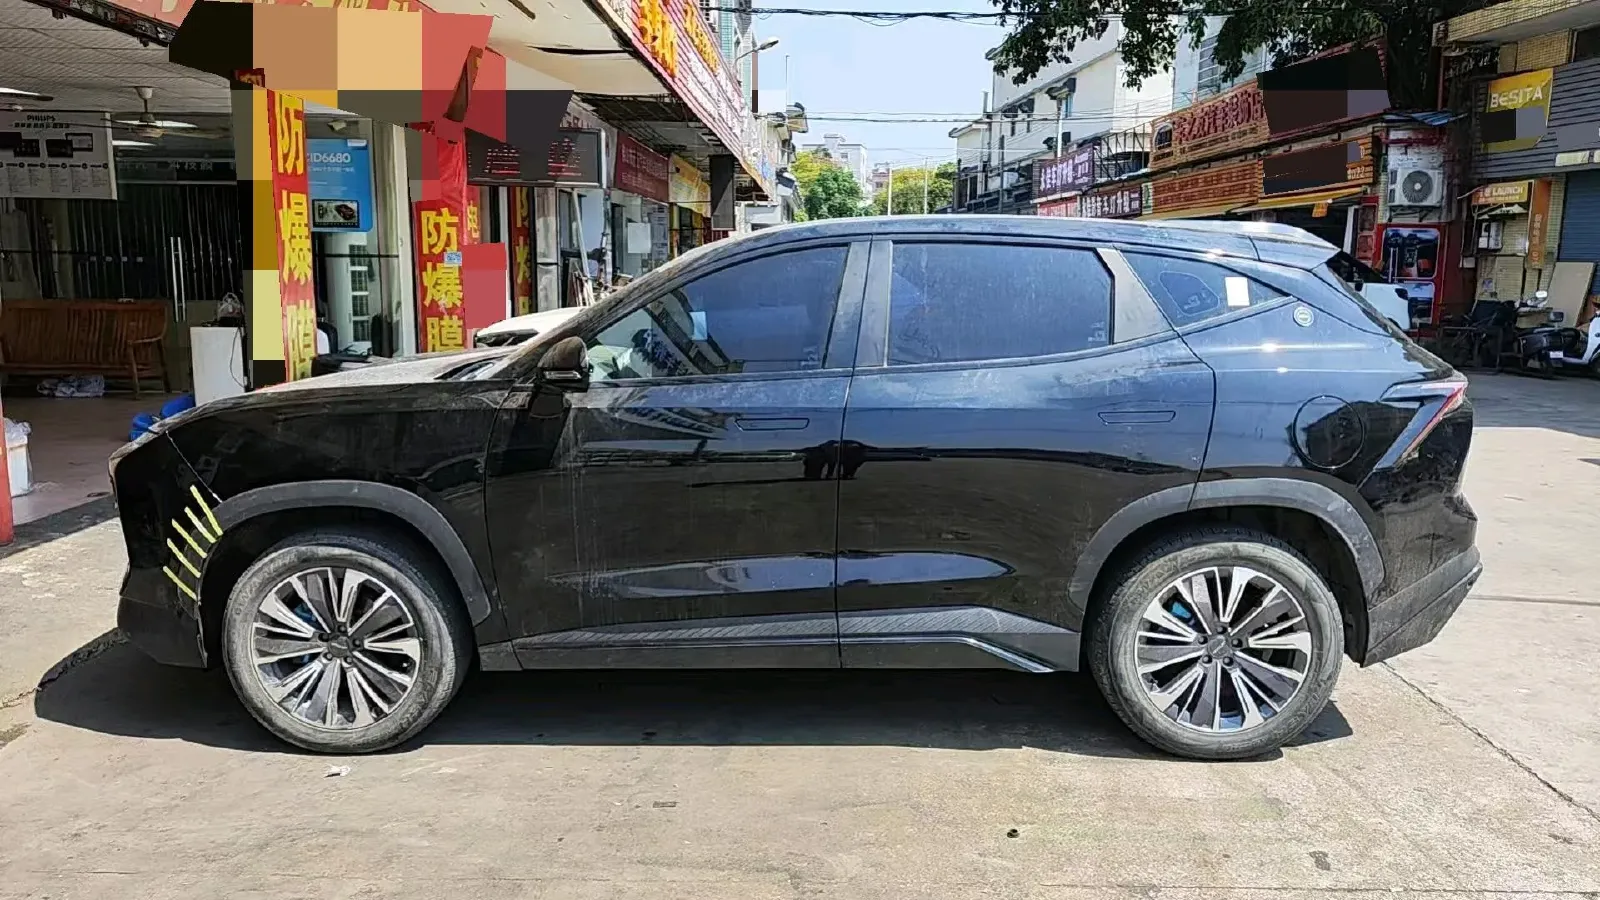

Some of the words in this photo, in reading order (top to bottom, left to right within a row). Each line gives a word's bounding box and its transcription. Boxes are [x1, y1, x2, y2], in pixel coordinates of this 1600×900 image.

[1489, 86, 1543, 108] BESITA
[273, 92, 312, 383] 防爆膜
[420, 207, 464, 353] 防爆膜
